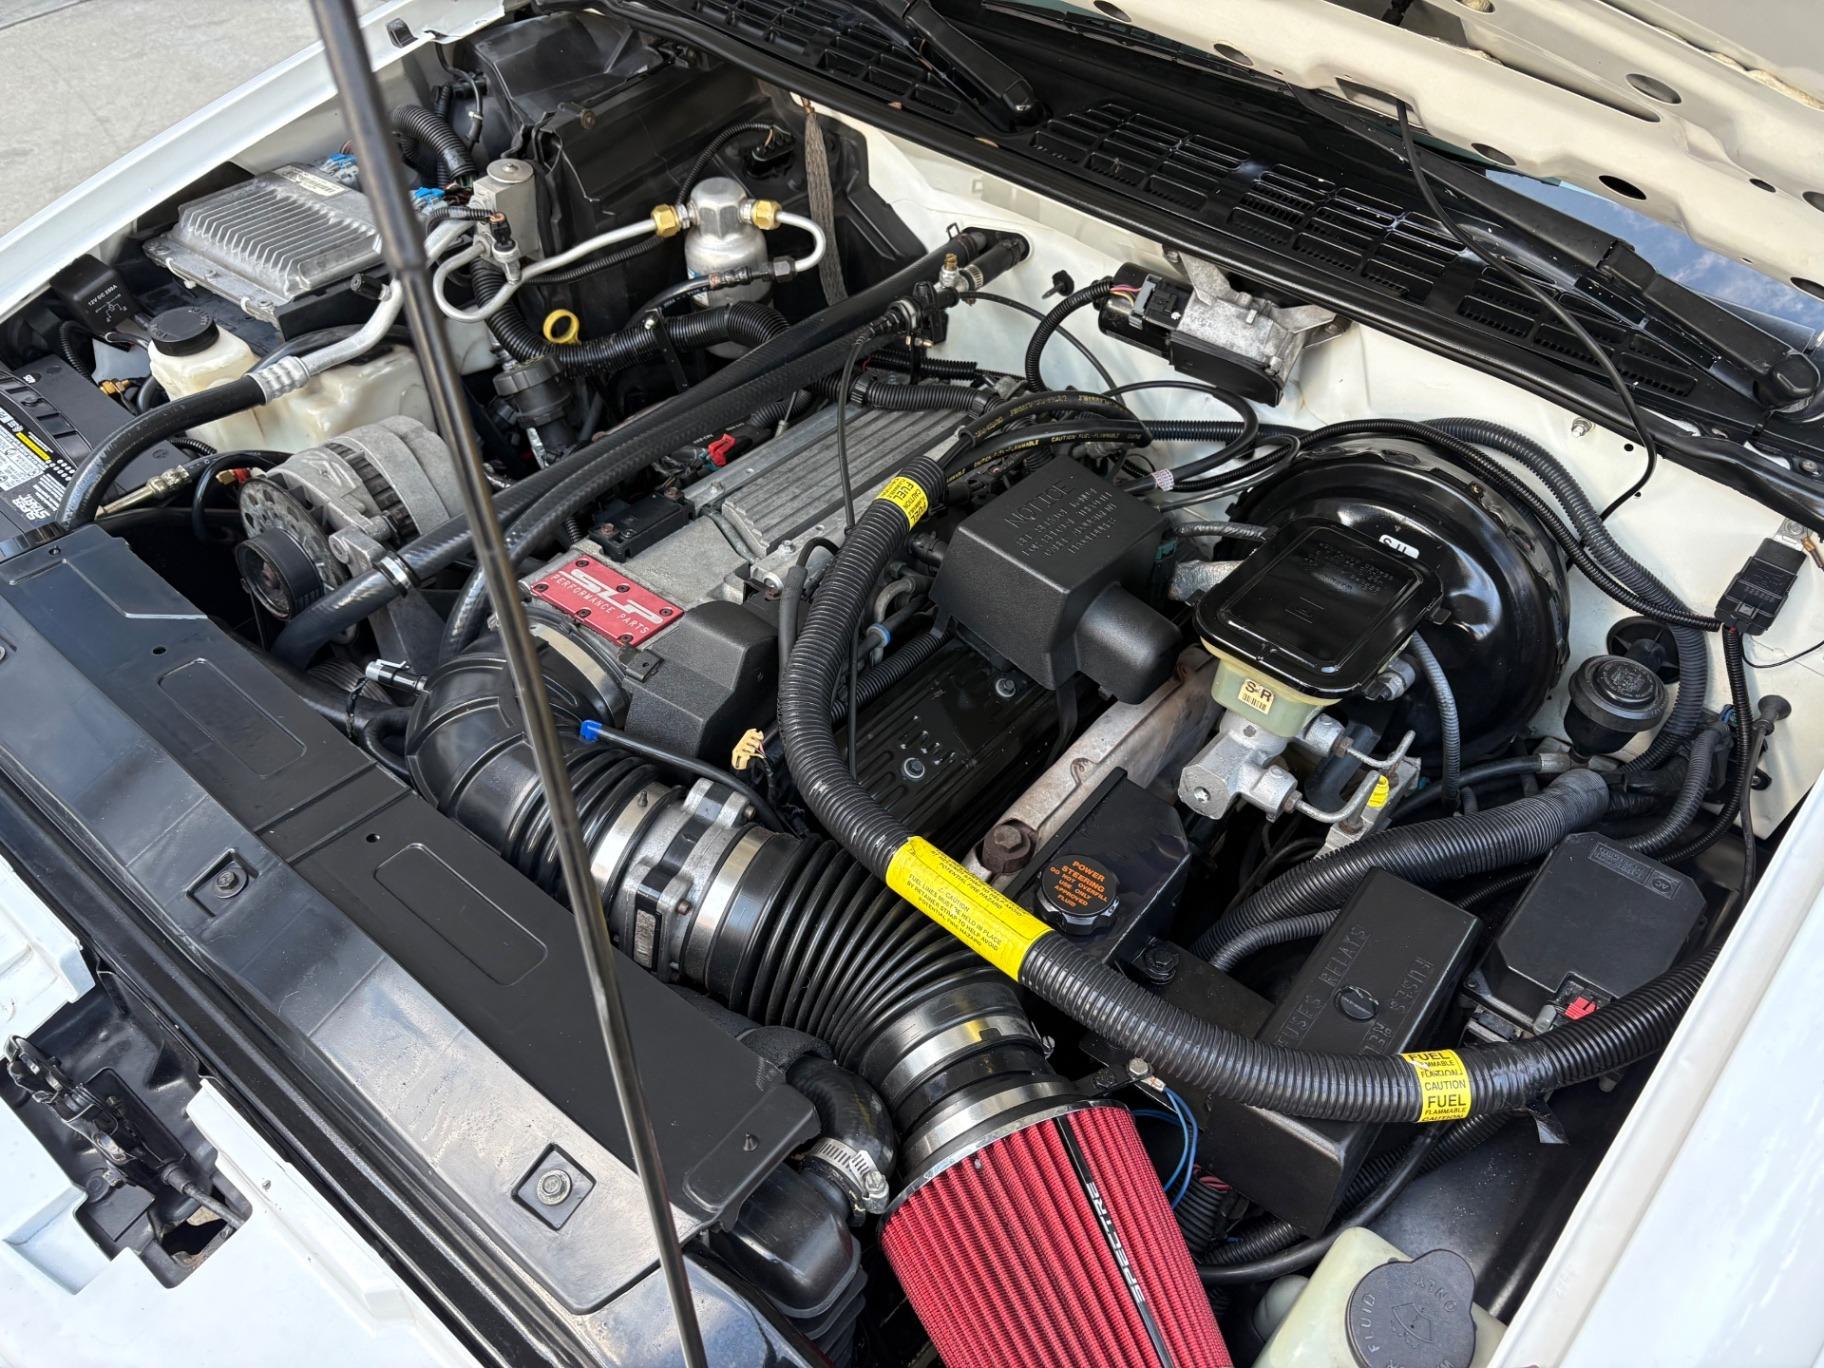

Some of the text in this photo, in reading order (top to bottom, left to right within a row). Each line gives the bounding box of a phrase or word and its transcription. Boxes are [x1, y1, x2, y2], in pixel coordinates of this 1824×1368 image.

[18, 494, 50, 519] START
[1004, 480, 1071, 528] NOTICE
[551, 574, 650, 634] PERFORMANCE PARTS
[558, 568, 664, 624] SLP
[1061, 865, 1105, 893] STEERING
[1072, 861, 1105, 882] POWER
[906, 880, 998, 951] BY RETAINER STRAP TO HELP AVOID
[908, 873, 923, 886] FUEL
[922, 884, 938, 897] LINES
[937, 895, 952, 908] MUST
[960, 912, 976, 926] HELD
[982, 928, 1001, 944] PLACE
[944, 891, 969, 912] CAUTION
[1275, 927, 1367, 1048] FUSES RELAYS
[1358, 956, 1434, 1054] FUSES REL
[1408, 1052, 1450, 1061] FUEL
[1425, 1080, 1466, 1091] CAUTION
[1428, 1094, 1466, 1108] FUEL
[1425, 1107, 1466, 1115] FLAMMABLE
[1086, 1182, 1145, 1303] SPECTRE
[1361, 1294, 1380, 1353] FLUID
